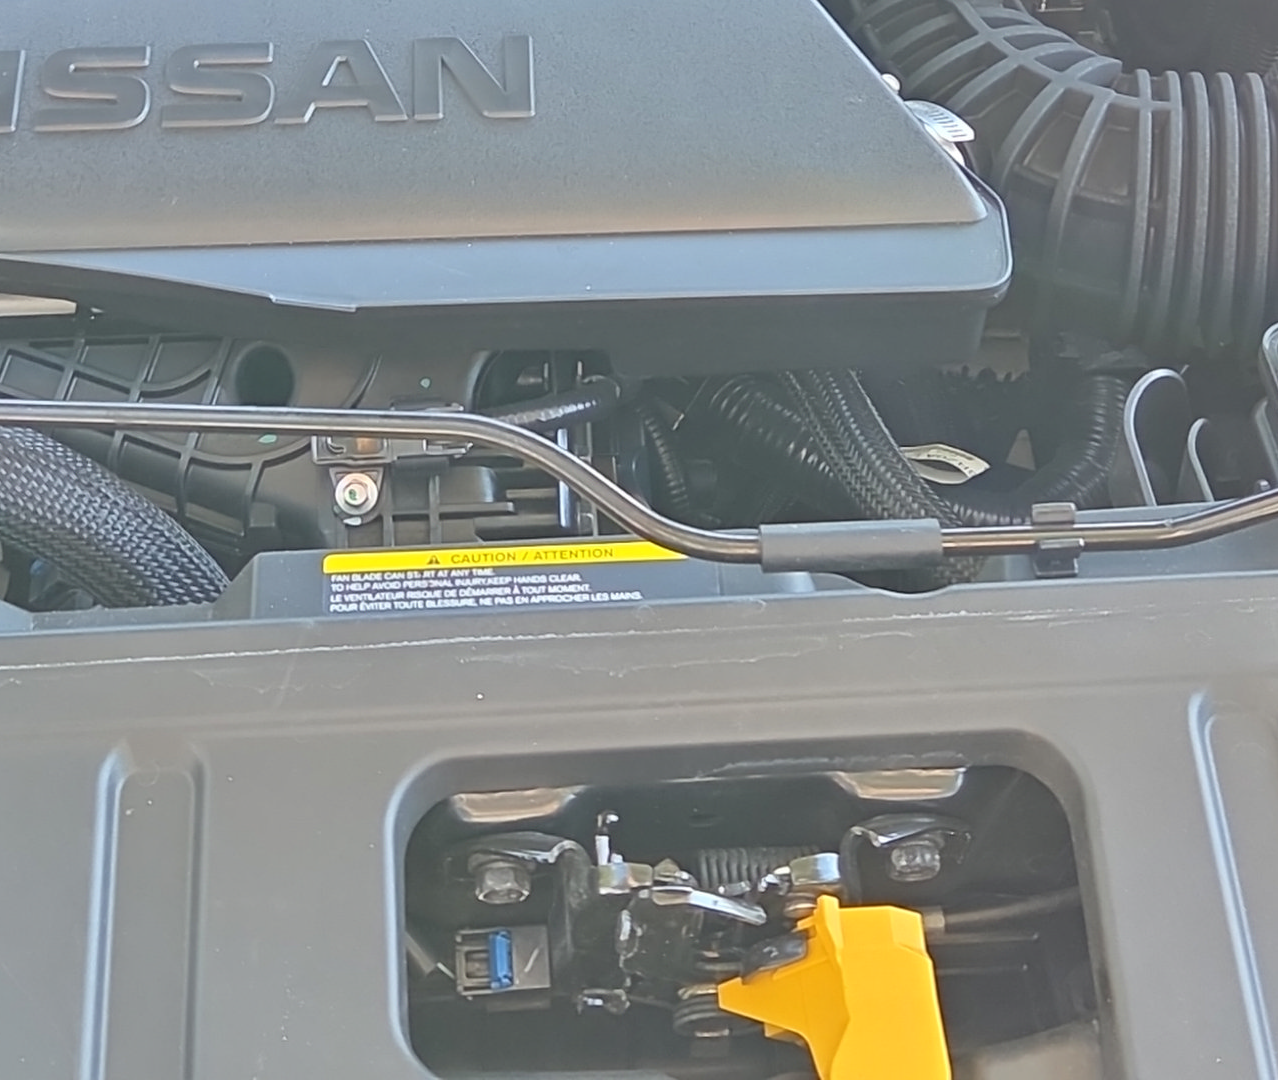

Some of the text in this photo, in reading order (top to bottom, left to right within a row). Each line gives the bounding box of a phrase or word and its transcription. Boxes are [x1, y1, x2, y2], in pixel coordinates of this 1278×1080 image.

[450, 548, 613, 565] CAUTION / ATTENTION
[331, 573, 350, 583] FAN
[351, 572, 382, 582] BLADE
[383, 571, 405, 581] CAN
[437, 569, 448, 578] AT
[450, 568, 470, 578] ANY
[331, 582, 344, 592] TO
[346, 581, 371, 591] HELP
[371, 581, 401, 590] AVOID
[513, 574, 547, 584] HANDS
[329, 603, 358, 612] POUR
[359, 601, 392, 611] ÉVITER
[393, 600, 424, 610] TOUTE
[479, 597, 493, 606] NE
[494, 596, 514, 605] PAS
[514, 595, 529, 605] EN
[530, 593, 590, 604] APPROCHER
[591, 592, 609, 602] LES
[330, 593, 342, 602] LE
[343, 591, 405, 602] VENTILATEUR
[406, 589, 442, 599] RISQUE
[443, 589, 457, 598] DE
[458, 586, 511, 597] DÉMARRER
[521, 585, 546, 594] TOUT
